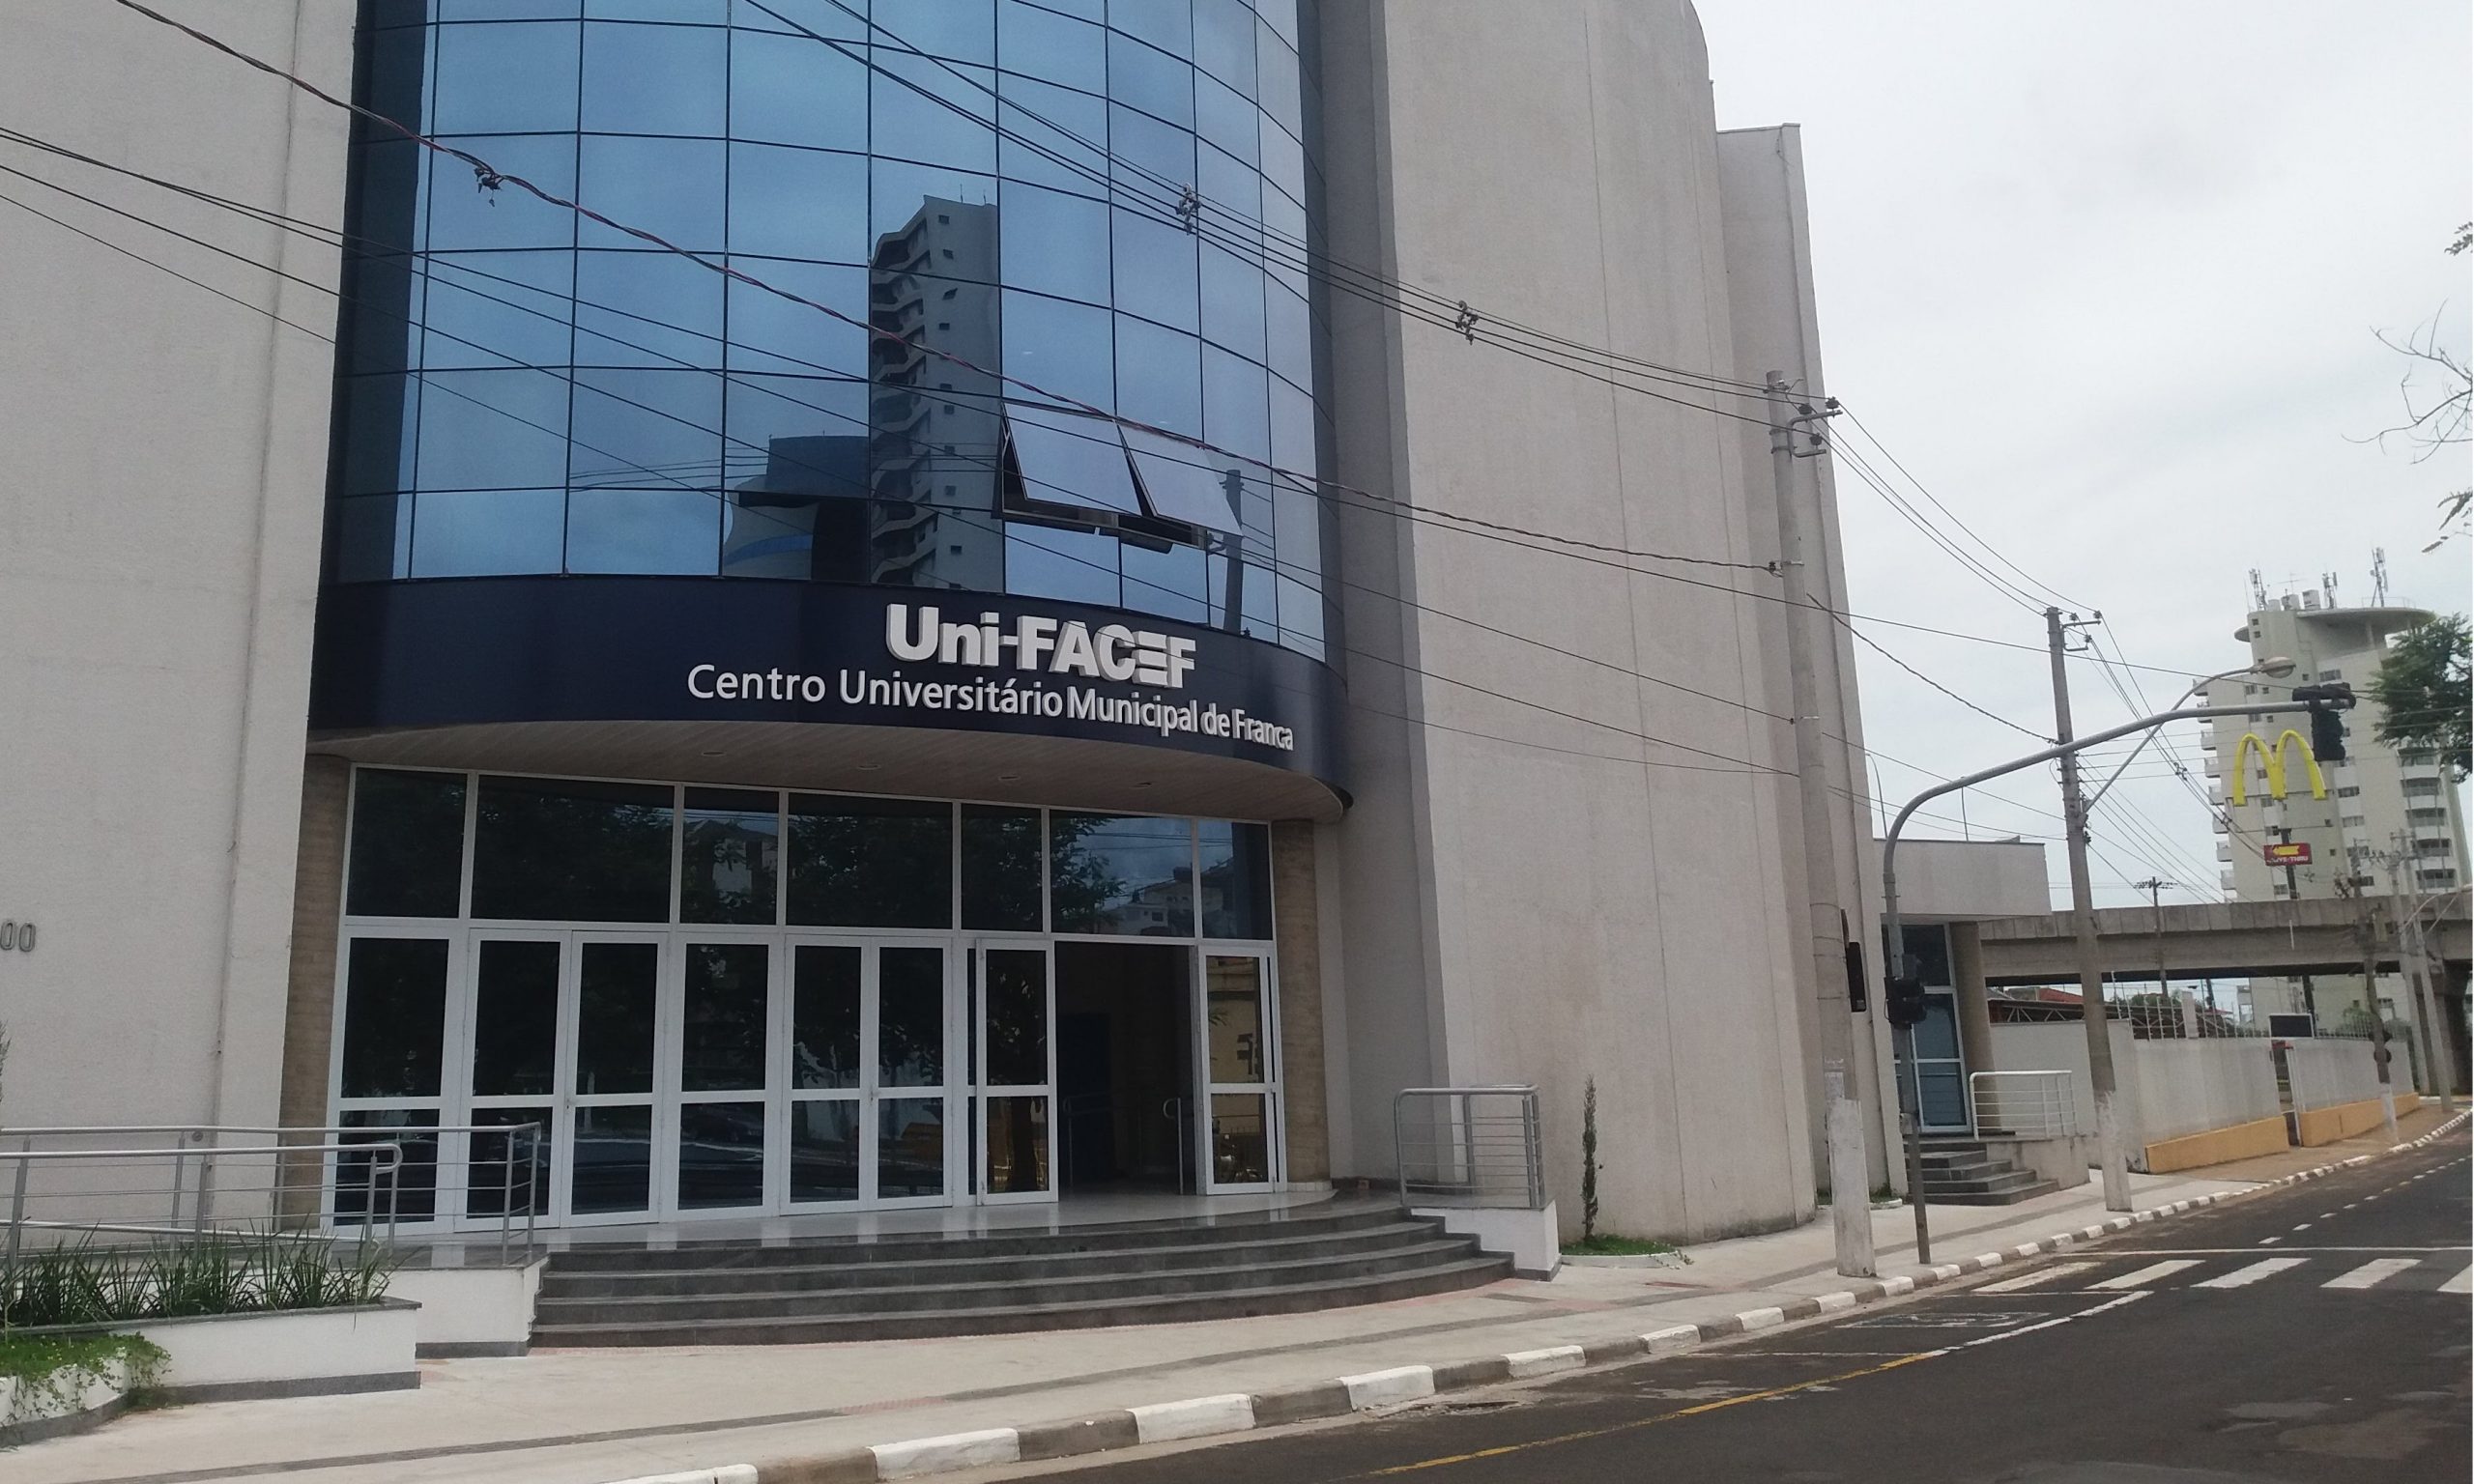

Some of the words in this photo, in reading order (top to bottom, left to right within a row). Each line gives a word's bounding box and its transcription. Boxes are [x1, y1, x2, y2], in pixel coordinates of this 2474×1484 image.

[886, 603, 1196, 689] Uni-FACEF
[687, 664, 826, 702] Centro
[839, 669, 1063, 717] Universitário
[1067, 686, 1197, 737] Municipal
[1200, 703, 1229, 737] de
[1231, 708, 1294, 751] Franca
